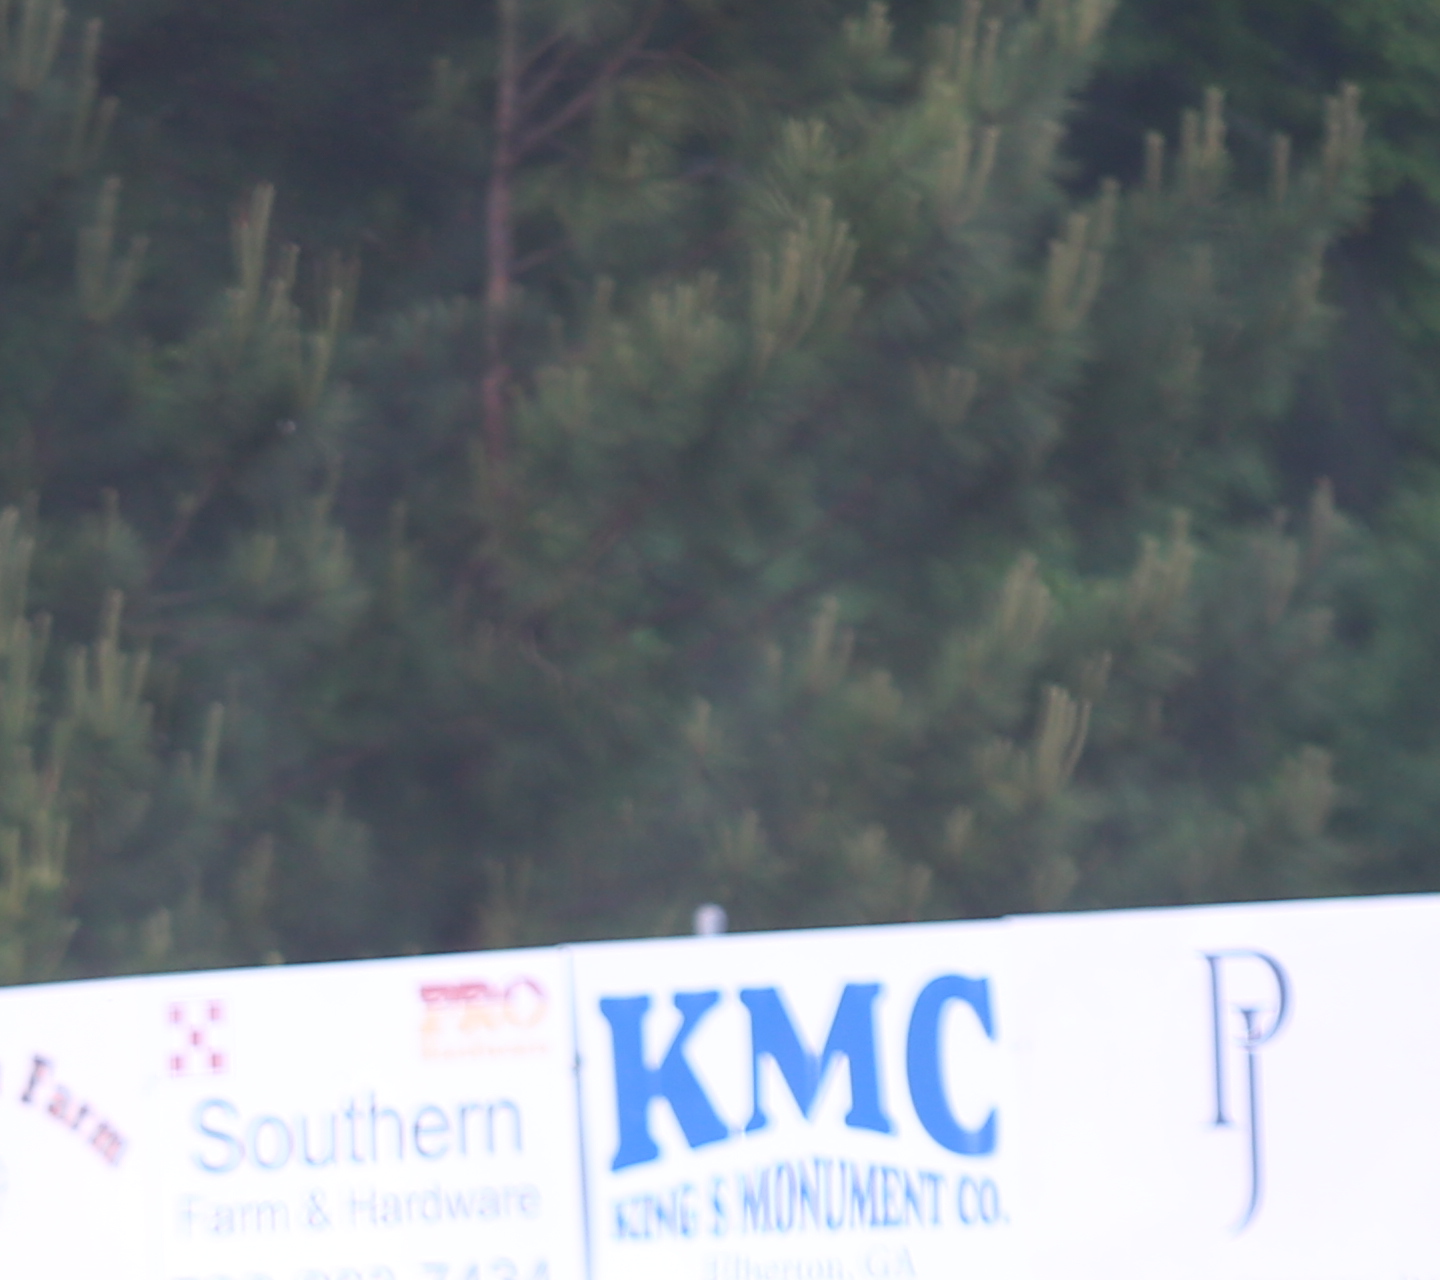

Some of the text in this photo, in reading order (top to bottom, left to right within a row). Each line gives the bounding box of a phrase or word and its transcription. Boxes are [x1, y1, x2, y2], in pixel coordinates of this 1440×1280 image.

[20, 1052, 128, 1168] Farm
[599, 973, 999, 1173] KMC
[191, 1090, 524, 1174] Southern
[177, 1182, 544, 1238] Farm & Hardware
[740, 1156, 945, 1234] MONUMENT
